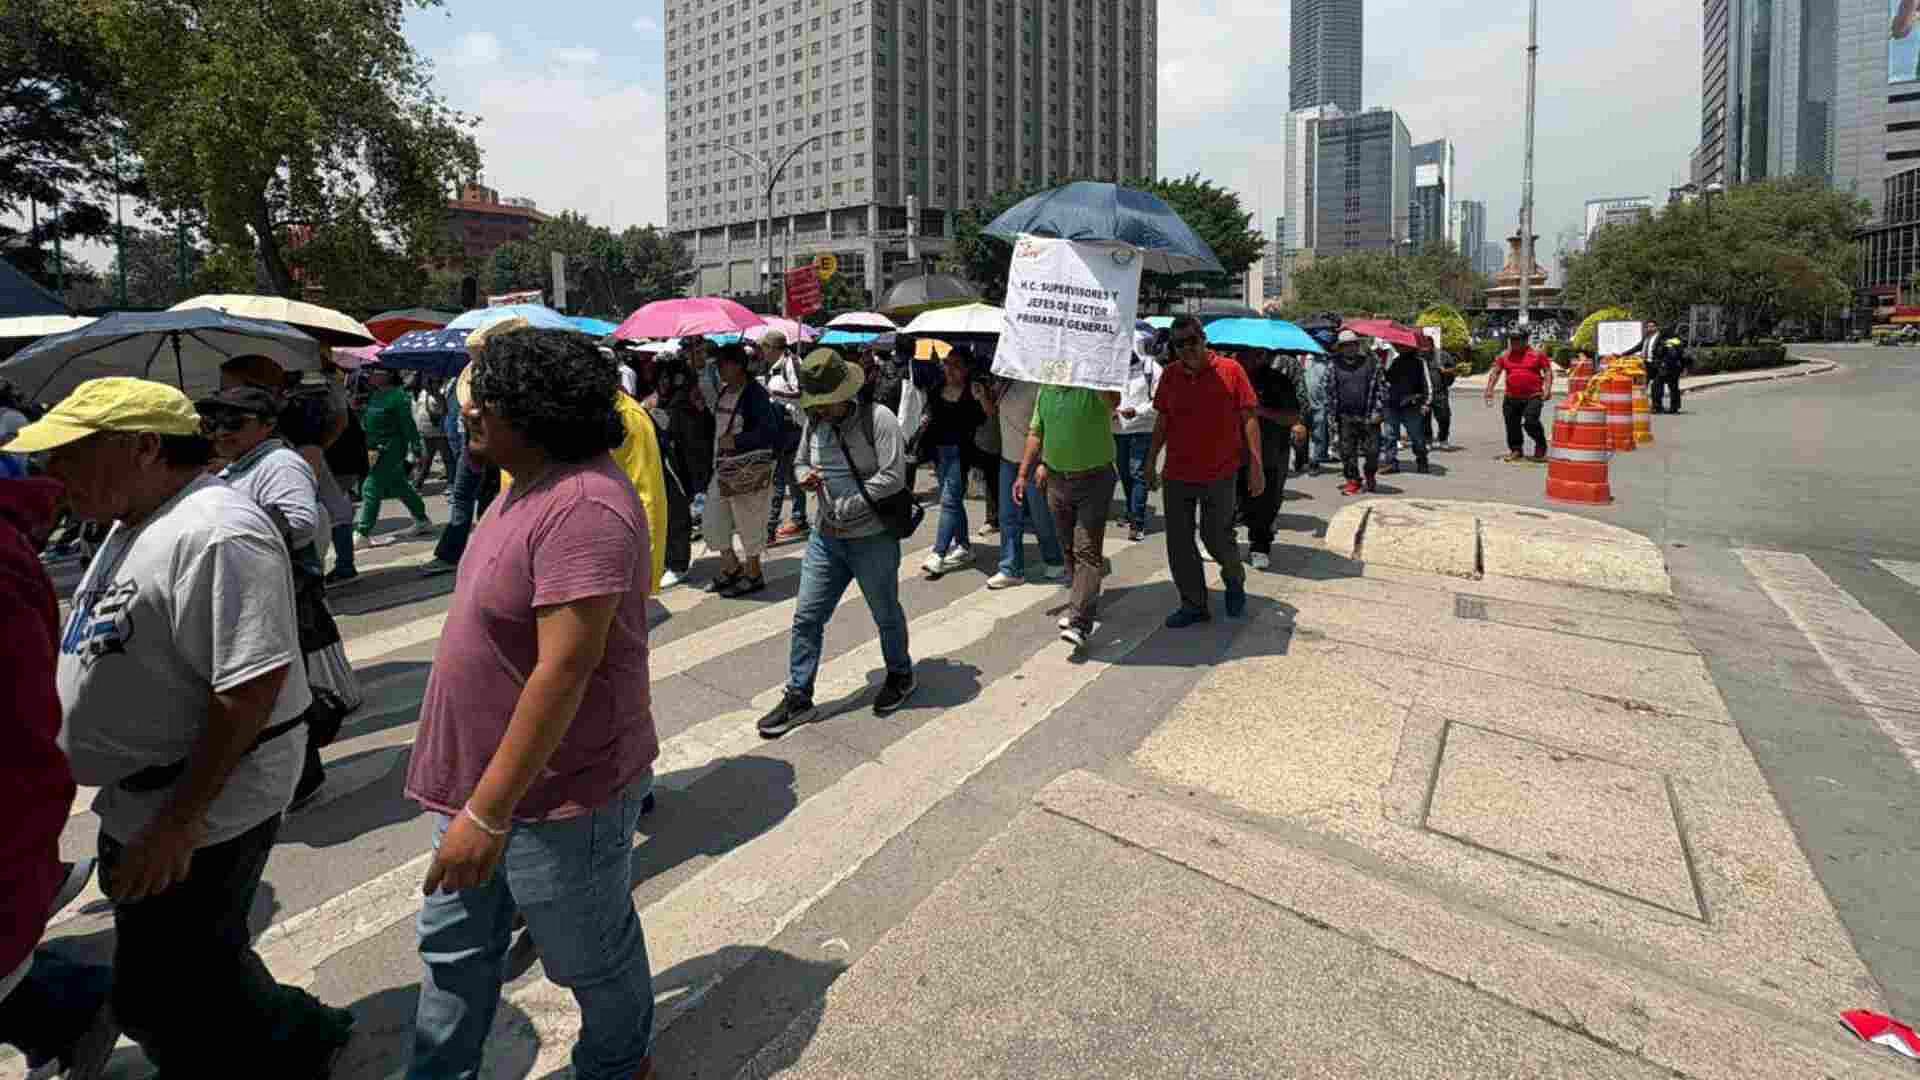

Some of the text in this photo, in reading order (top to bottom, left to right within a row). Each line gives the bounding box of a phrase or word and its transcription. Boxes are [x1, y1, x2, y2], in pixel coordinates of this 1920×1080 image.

[1041, 282, 1109, 300] SUPERVISORES
[1111, 290, 1119, 301] Y
[1027, 298, 1108, 317] JEFES DE SECTOR
[1017, 313, 1115, 335] PRIMARIA GENERAL
